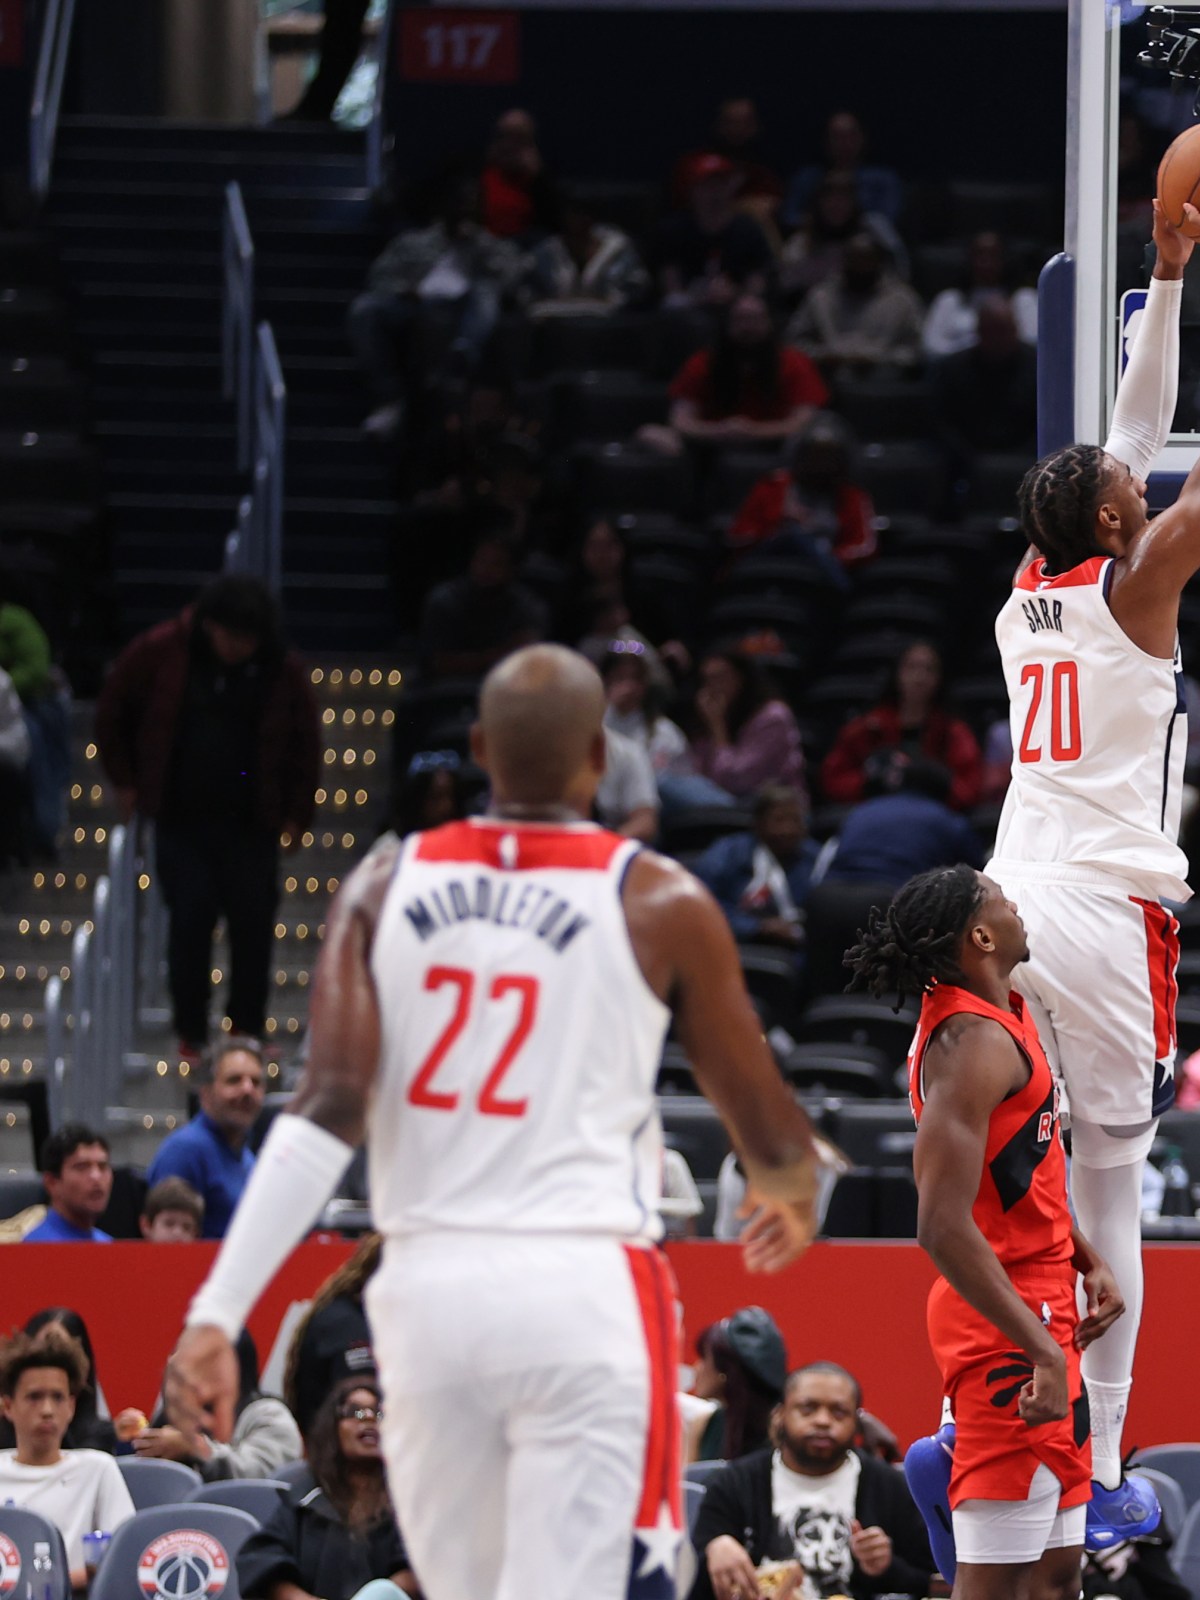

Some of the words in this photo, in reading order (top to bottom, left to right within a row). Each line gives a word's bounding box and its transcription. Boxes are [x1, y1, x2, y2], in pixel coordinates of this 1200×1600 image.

[421, 22, 502, 69] 117
[1021, 597, 1064, 634] SARR
[1018, 661, 1082, 764] 20
[403, 875, 592, 955] MIDDLETON
[407, 963, 541, 1118] 22
